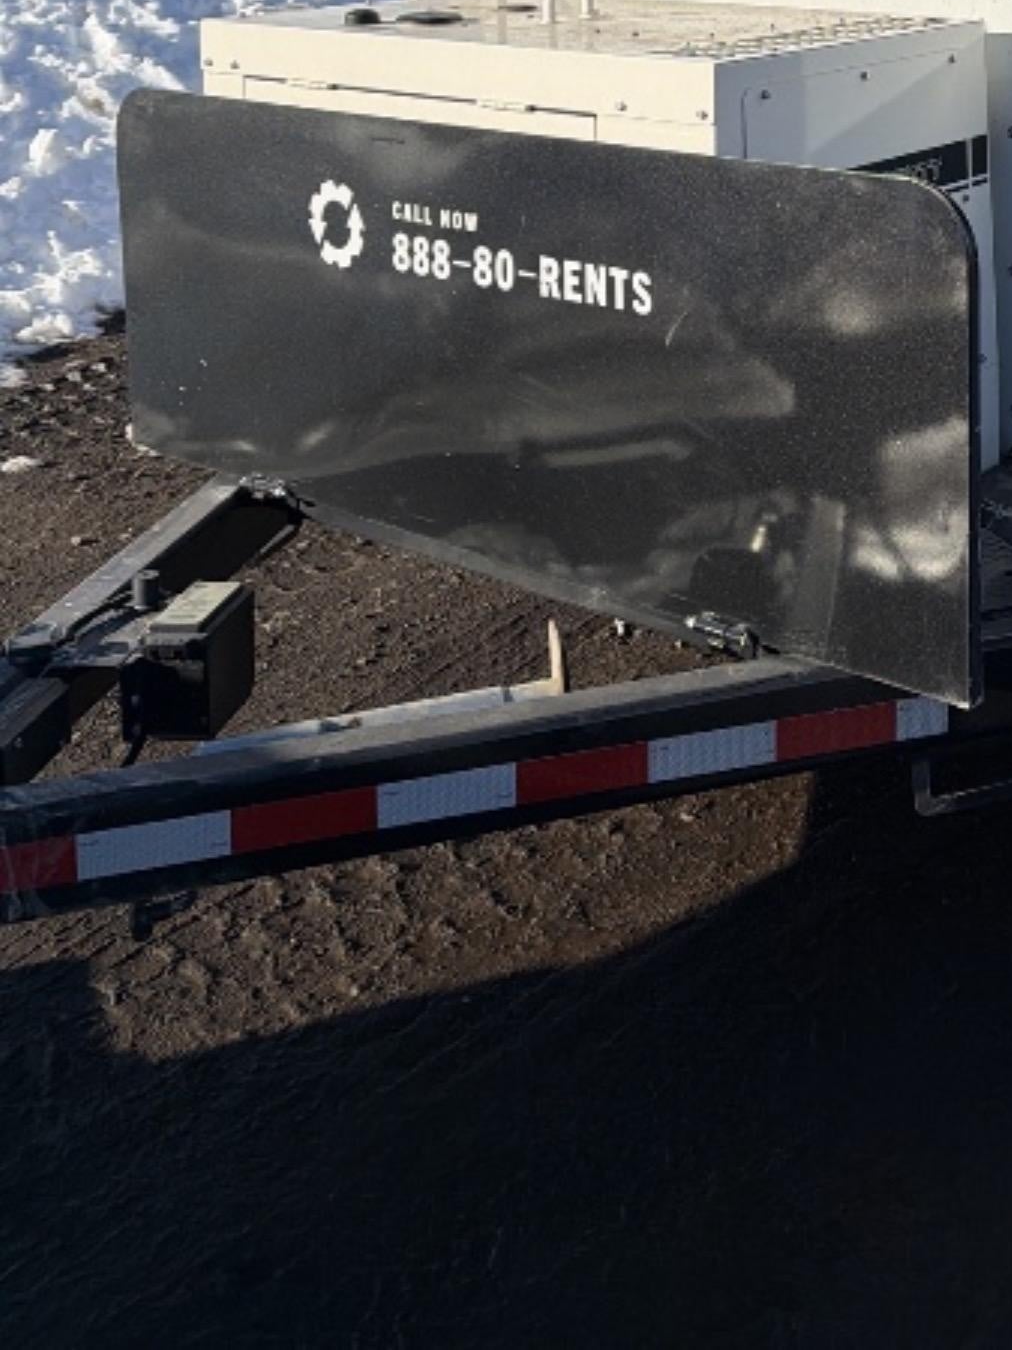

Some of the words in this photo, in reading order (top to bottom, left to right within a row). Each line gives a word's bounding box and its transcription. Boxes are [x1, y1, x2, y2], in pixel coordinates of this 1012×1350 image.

[391, 201, 433, 227] CALL
[440, 209, 478, 232] NOW
[392, 233, 653, 316] 888-80-RENTS
